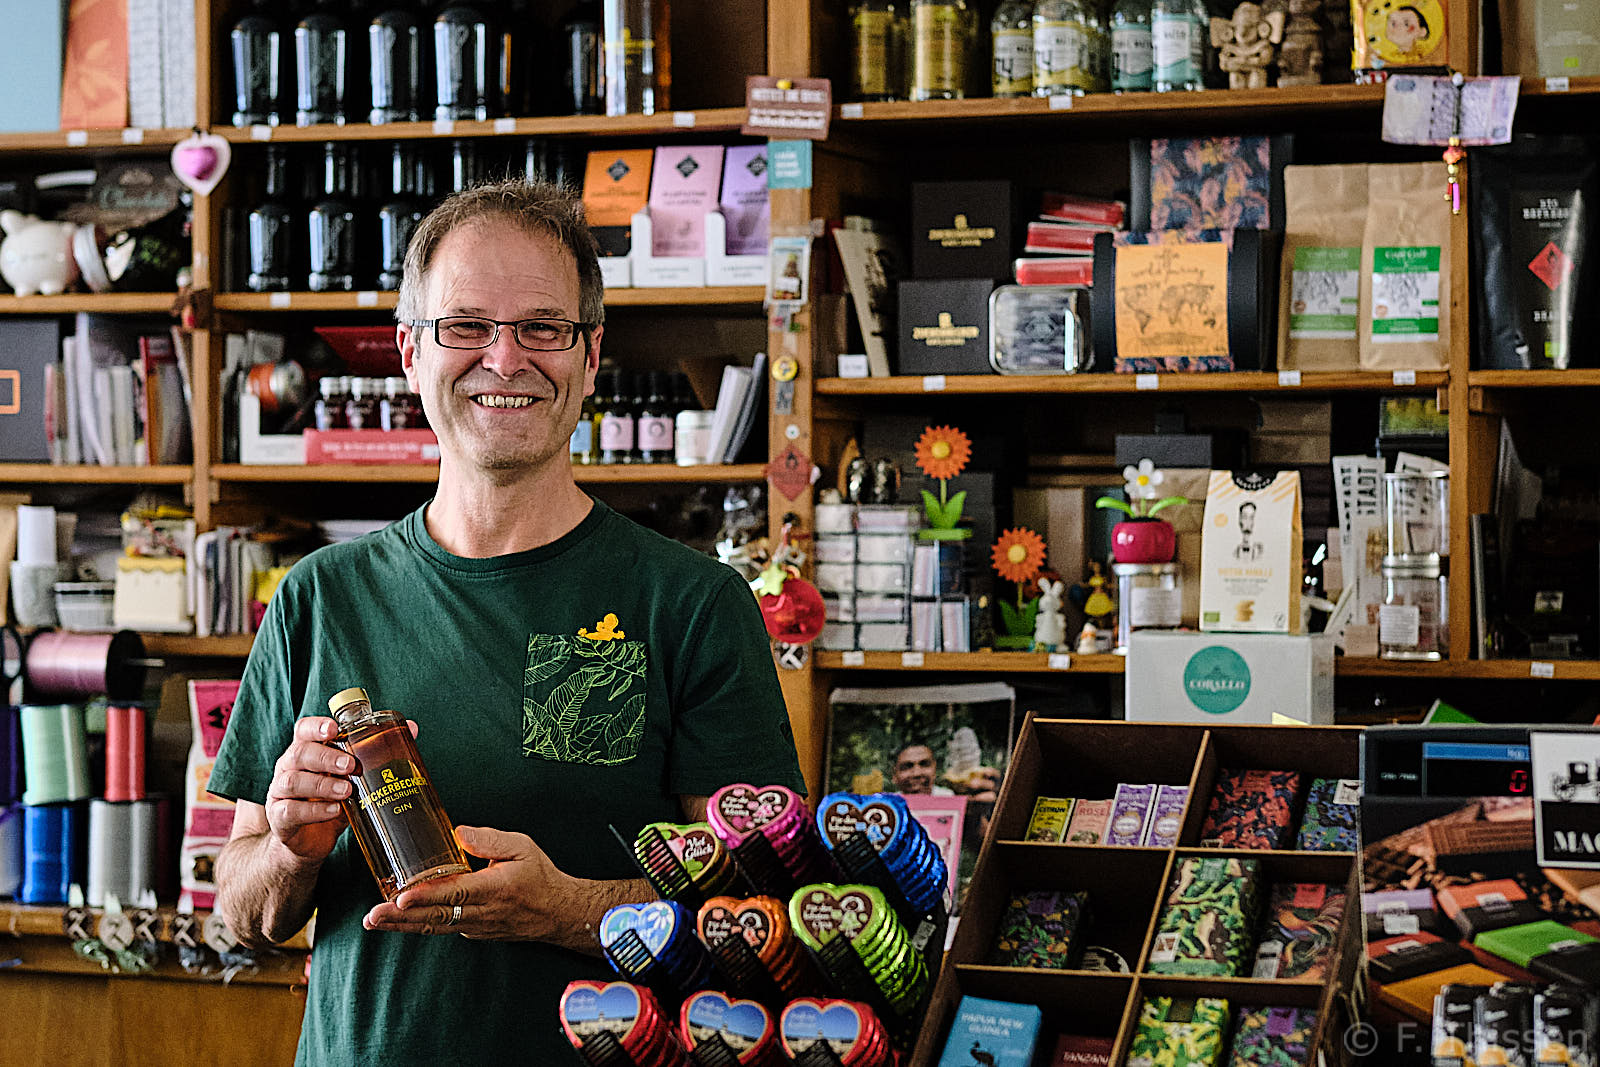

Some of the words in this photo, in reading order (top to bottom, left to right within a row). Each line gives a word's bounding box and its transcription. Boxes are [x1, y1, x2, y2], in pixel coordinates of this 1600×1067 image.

[1509, 770, 1527, 793] 0
[376, 787, 419, 808] KARLSRUHE
[393, 802, 413, 815] GIN
[686, 836, 706, 847] Viel
[685, 843, 713, 861] Glück
[961, 1013, 996, 1025] PAPUA
[998, 1018, 1024, 1030] NEW
